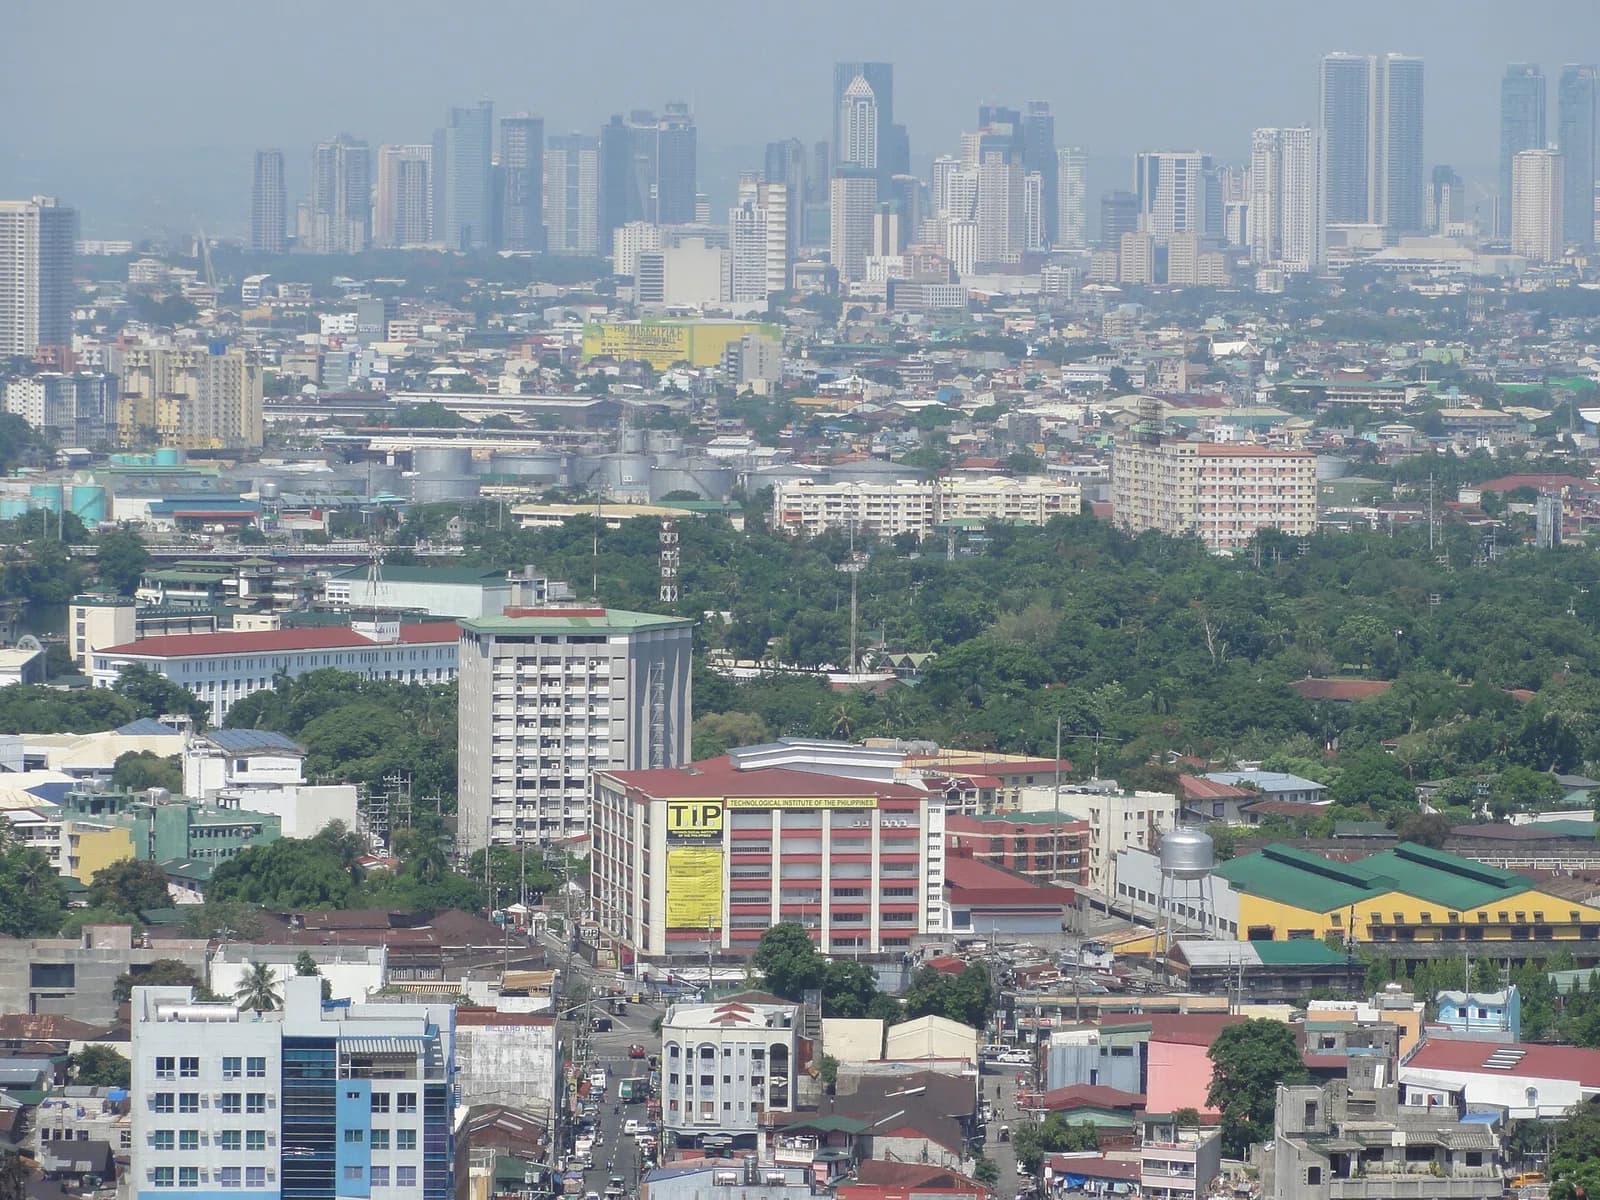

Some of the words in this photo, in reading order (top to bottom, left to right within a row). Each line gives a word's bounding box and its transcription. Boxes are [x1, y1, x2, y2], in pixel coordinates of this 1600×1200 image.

[730, 799, 780, 807] TECHNOLOGICAL
[782, 799, 812, 807] INSTITUTE
[814, 799, 823, 807] OF
[824, 799, 836, 807] THE
